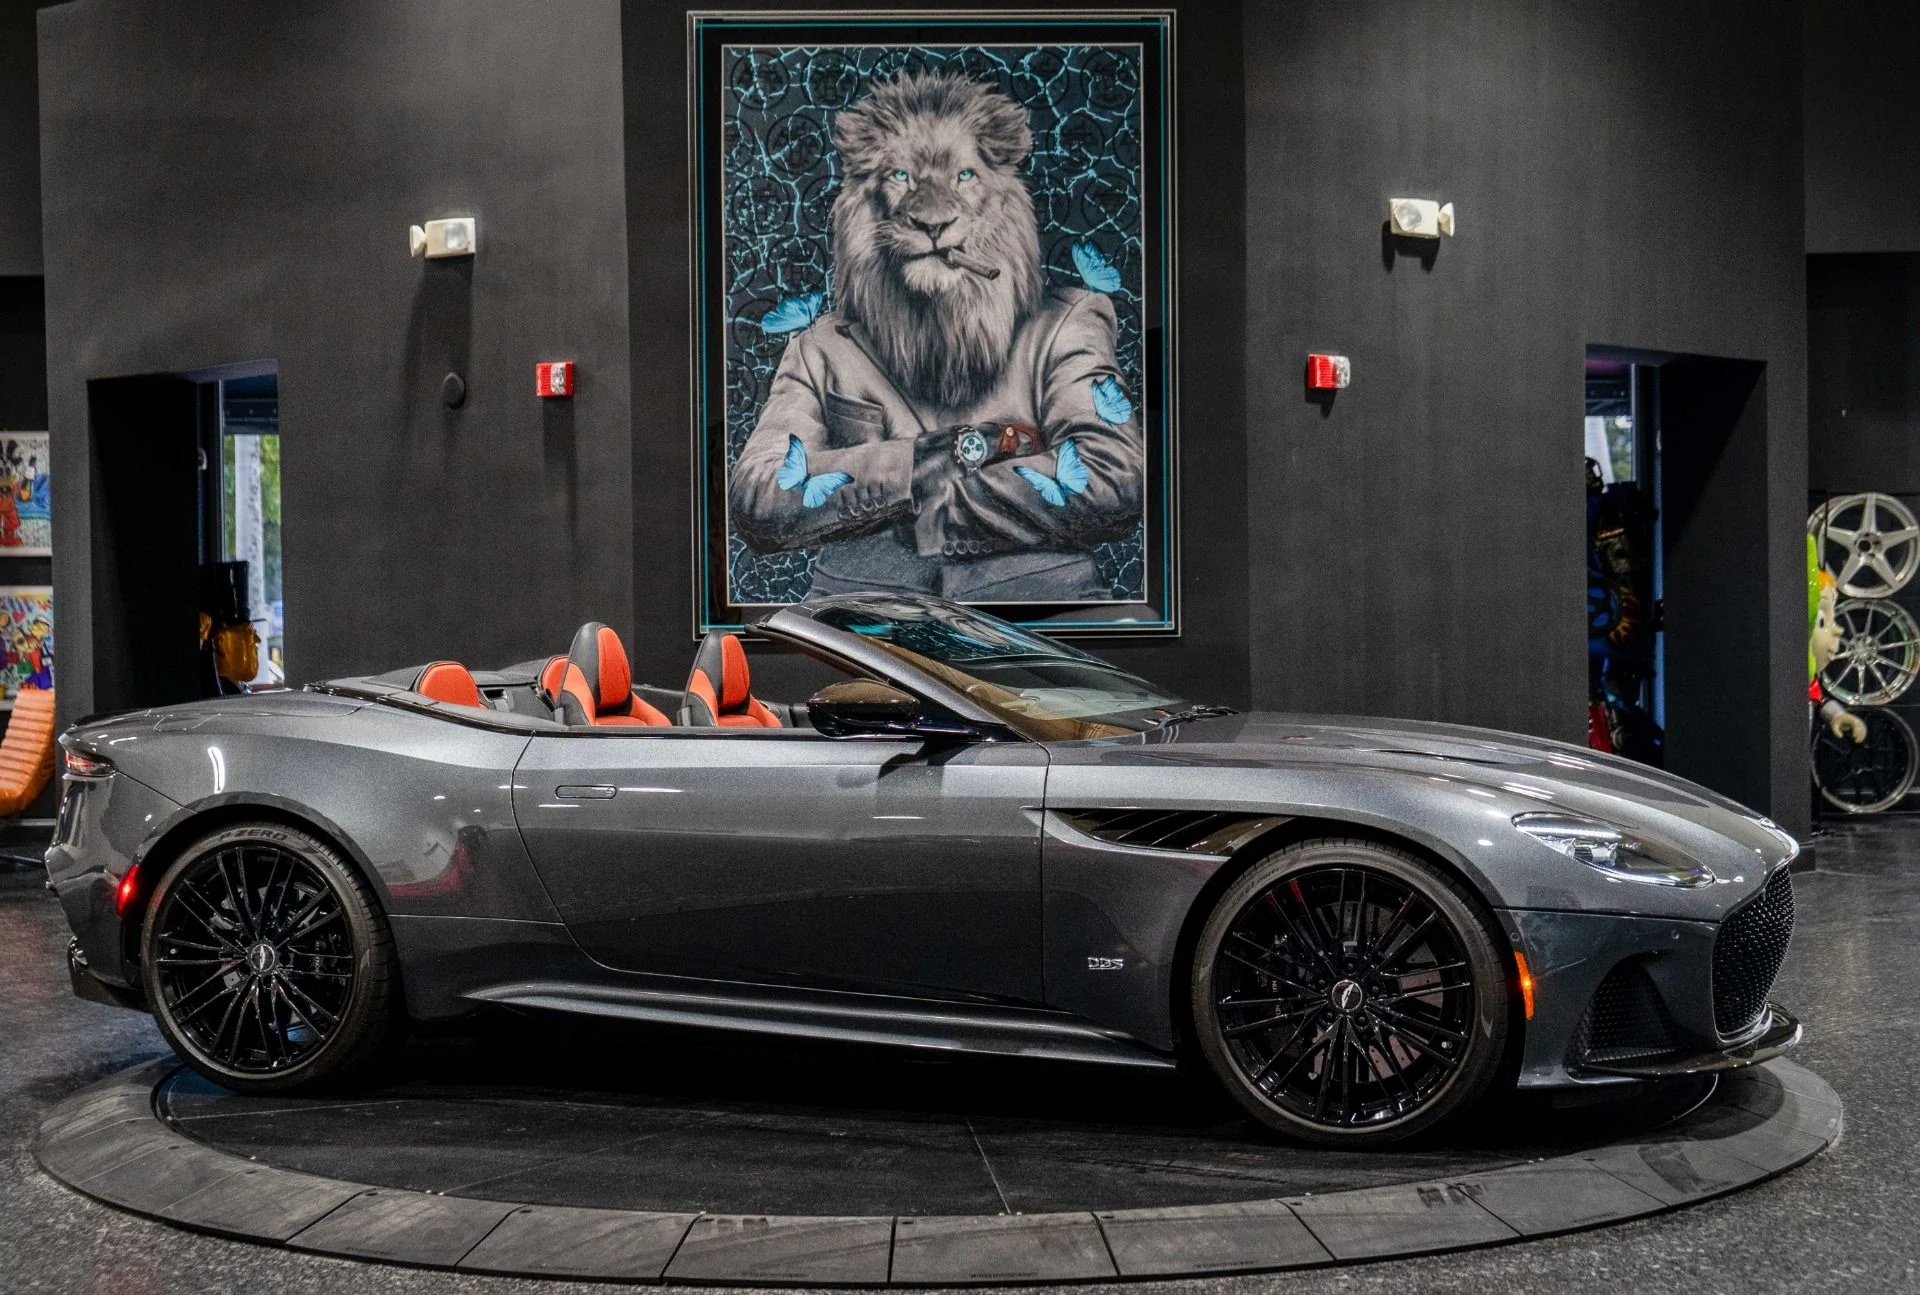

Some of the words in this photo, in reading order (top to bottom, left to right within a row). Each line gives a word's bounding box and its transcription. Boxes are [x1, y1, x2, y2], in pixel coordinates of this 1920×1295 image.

[219, 831, 231, 840] P
[234, 829, 288, 841] ZERO
[1088, 957, 1124, 970] DBS
